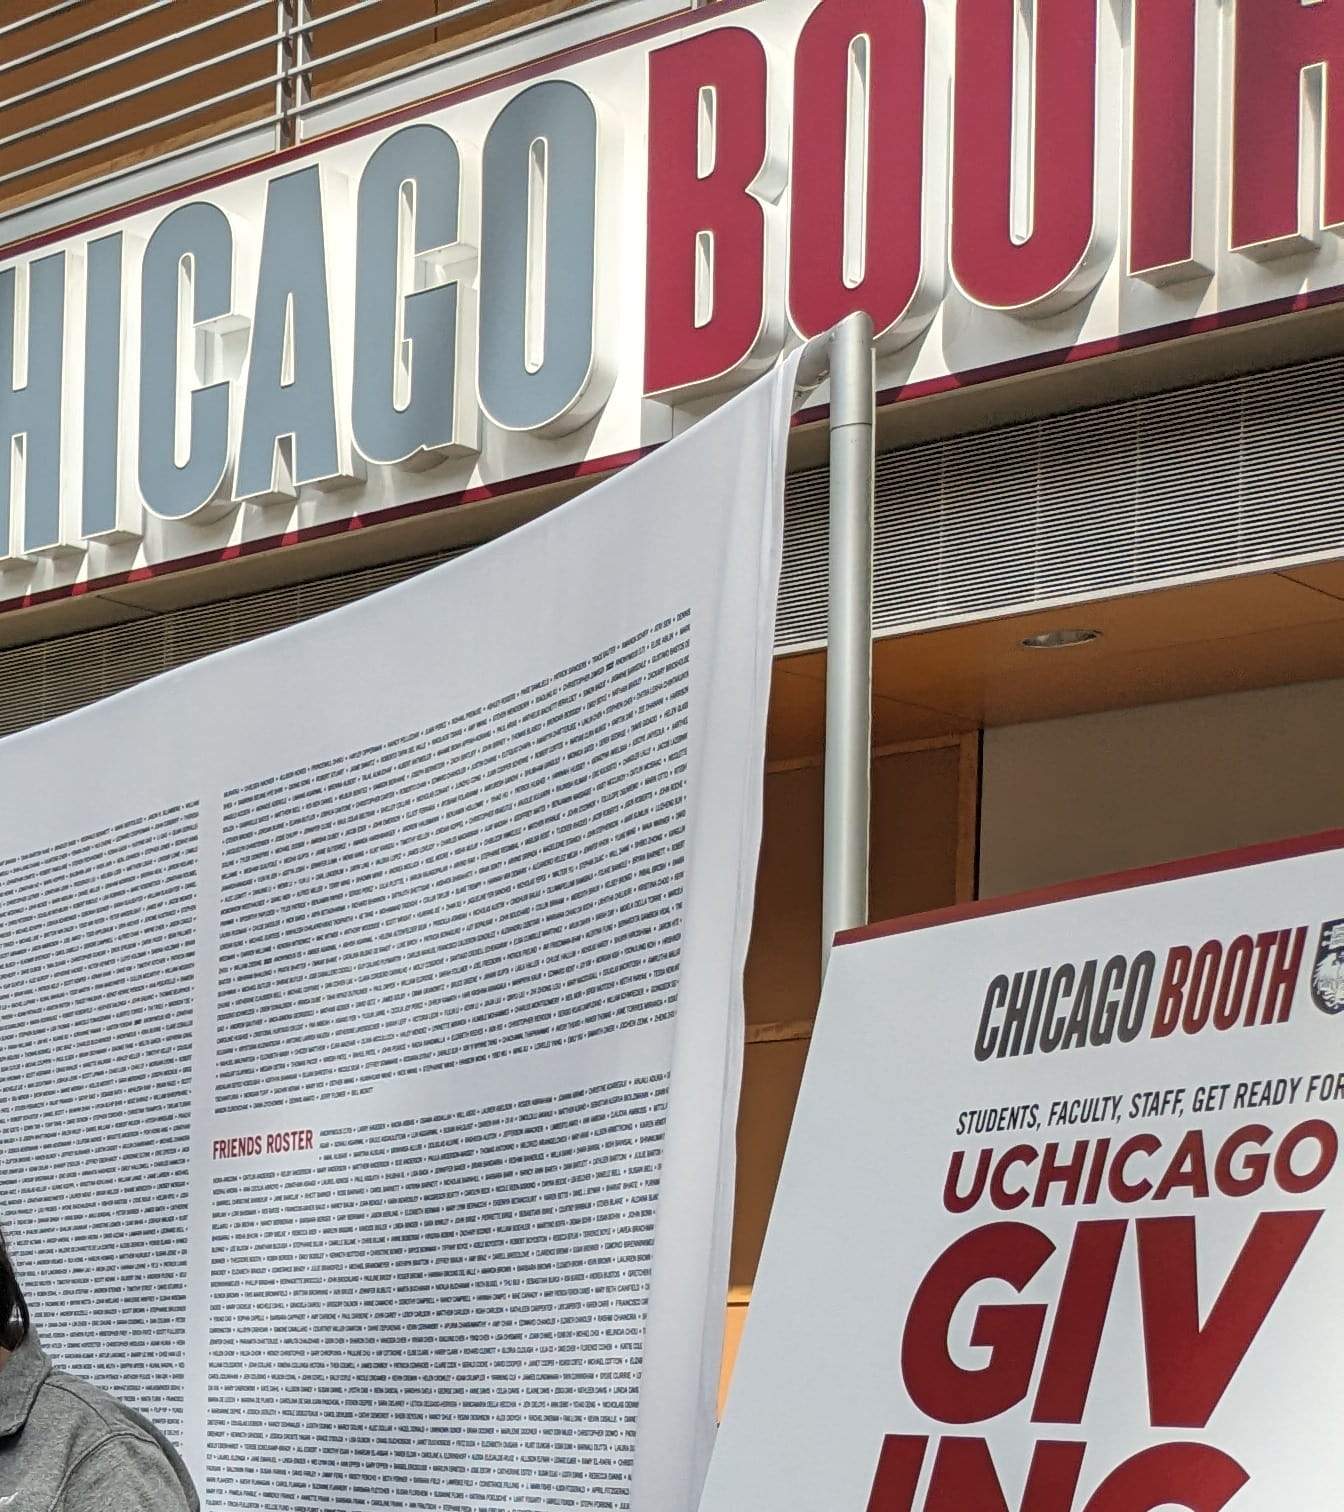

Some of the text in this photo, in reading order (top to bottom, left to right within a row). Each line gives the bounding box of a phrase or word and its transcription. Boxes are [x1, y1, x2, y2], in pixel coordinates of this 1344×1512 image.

[973, 925, 1310, 1063] CHICAGO BOOTH
[212, 1129, 314, 1160] FRIENDS ROSTER
[955, 1072, 1344, 1137] STUDENTS, FACULTY, STAFF, GET READY FOR
[941, 1118, 1339, 1214] UCHICAGO
[900, 1207, 1326, 1429] GIV
